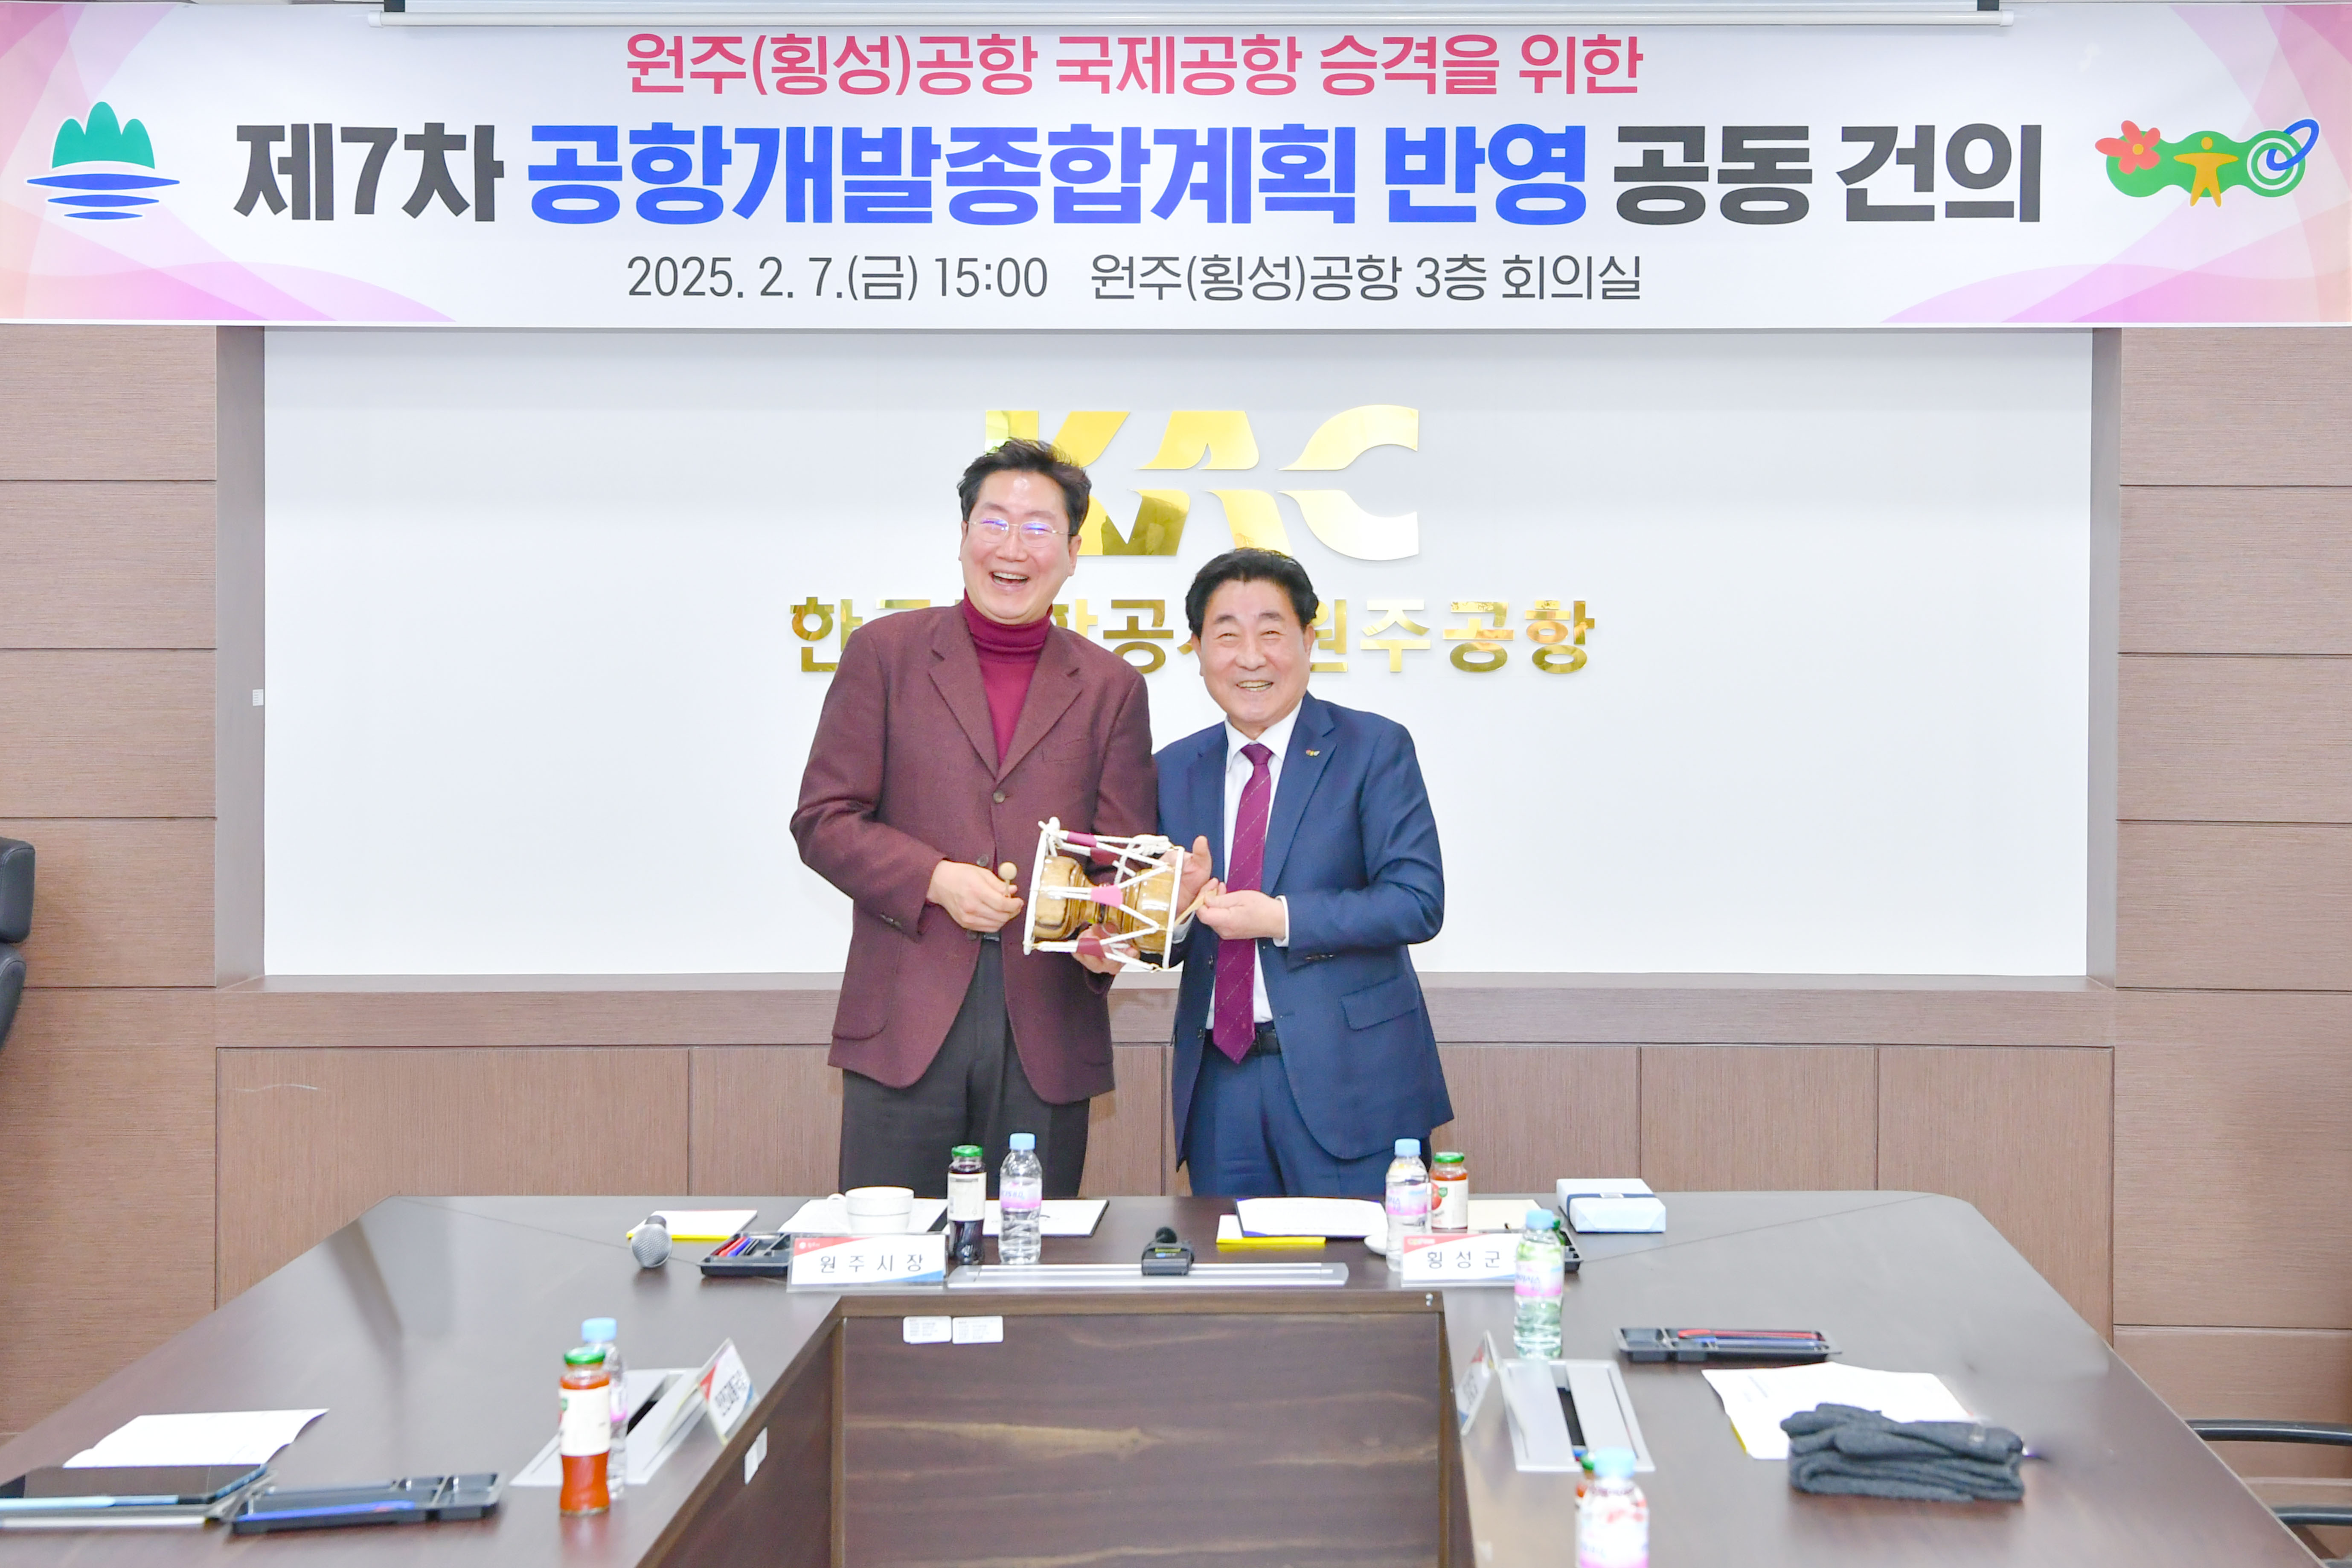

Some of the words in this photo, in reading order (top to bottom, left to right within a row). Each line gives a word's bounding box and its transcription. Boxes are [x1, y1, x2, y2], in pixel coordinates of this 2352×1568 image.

[627, 33, 1038, 95] 원주(횡성)공항
[1056, 34, 1302, 96] 국제공항
[1320, 34, 1500, 96] 승격을
[1519, 34, 1643, 94] 위한
[234, 122, 504, 222] 제7차
[528, 122, 1355, 225] 공항개발종합계획
[1385, 123, 1586, 225] 반영
[1614, 126, 1812, 225] 공동
[1836, 123, 2041, 222] 건의
[628, 256, 743, 298] 2025.
[759, 256, 793, 298] 2.
[809, 255, 917, 301] 7.(금)
[935, 257, 1047, 297] 15:00
[1091, 254, 1402, 301] 원주(횡성)공항
[1416, 254, 1486, 301] 3층
[1502, 254, 1640, 300] 회의실
[1427, 1251, 1516, 1269] 횡성군
